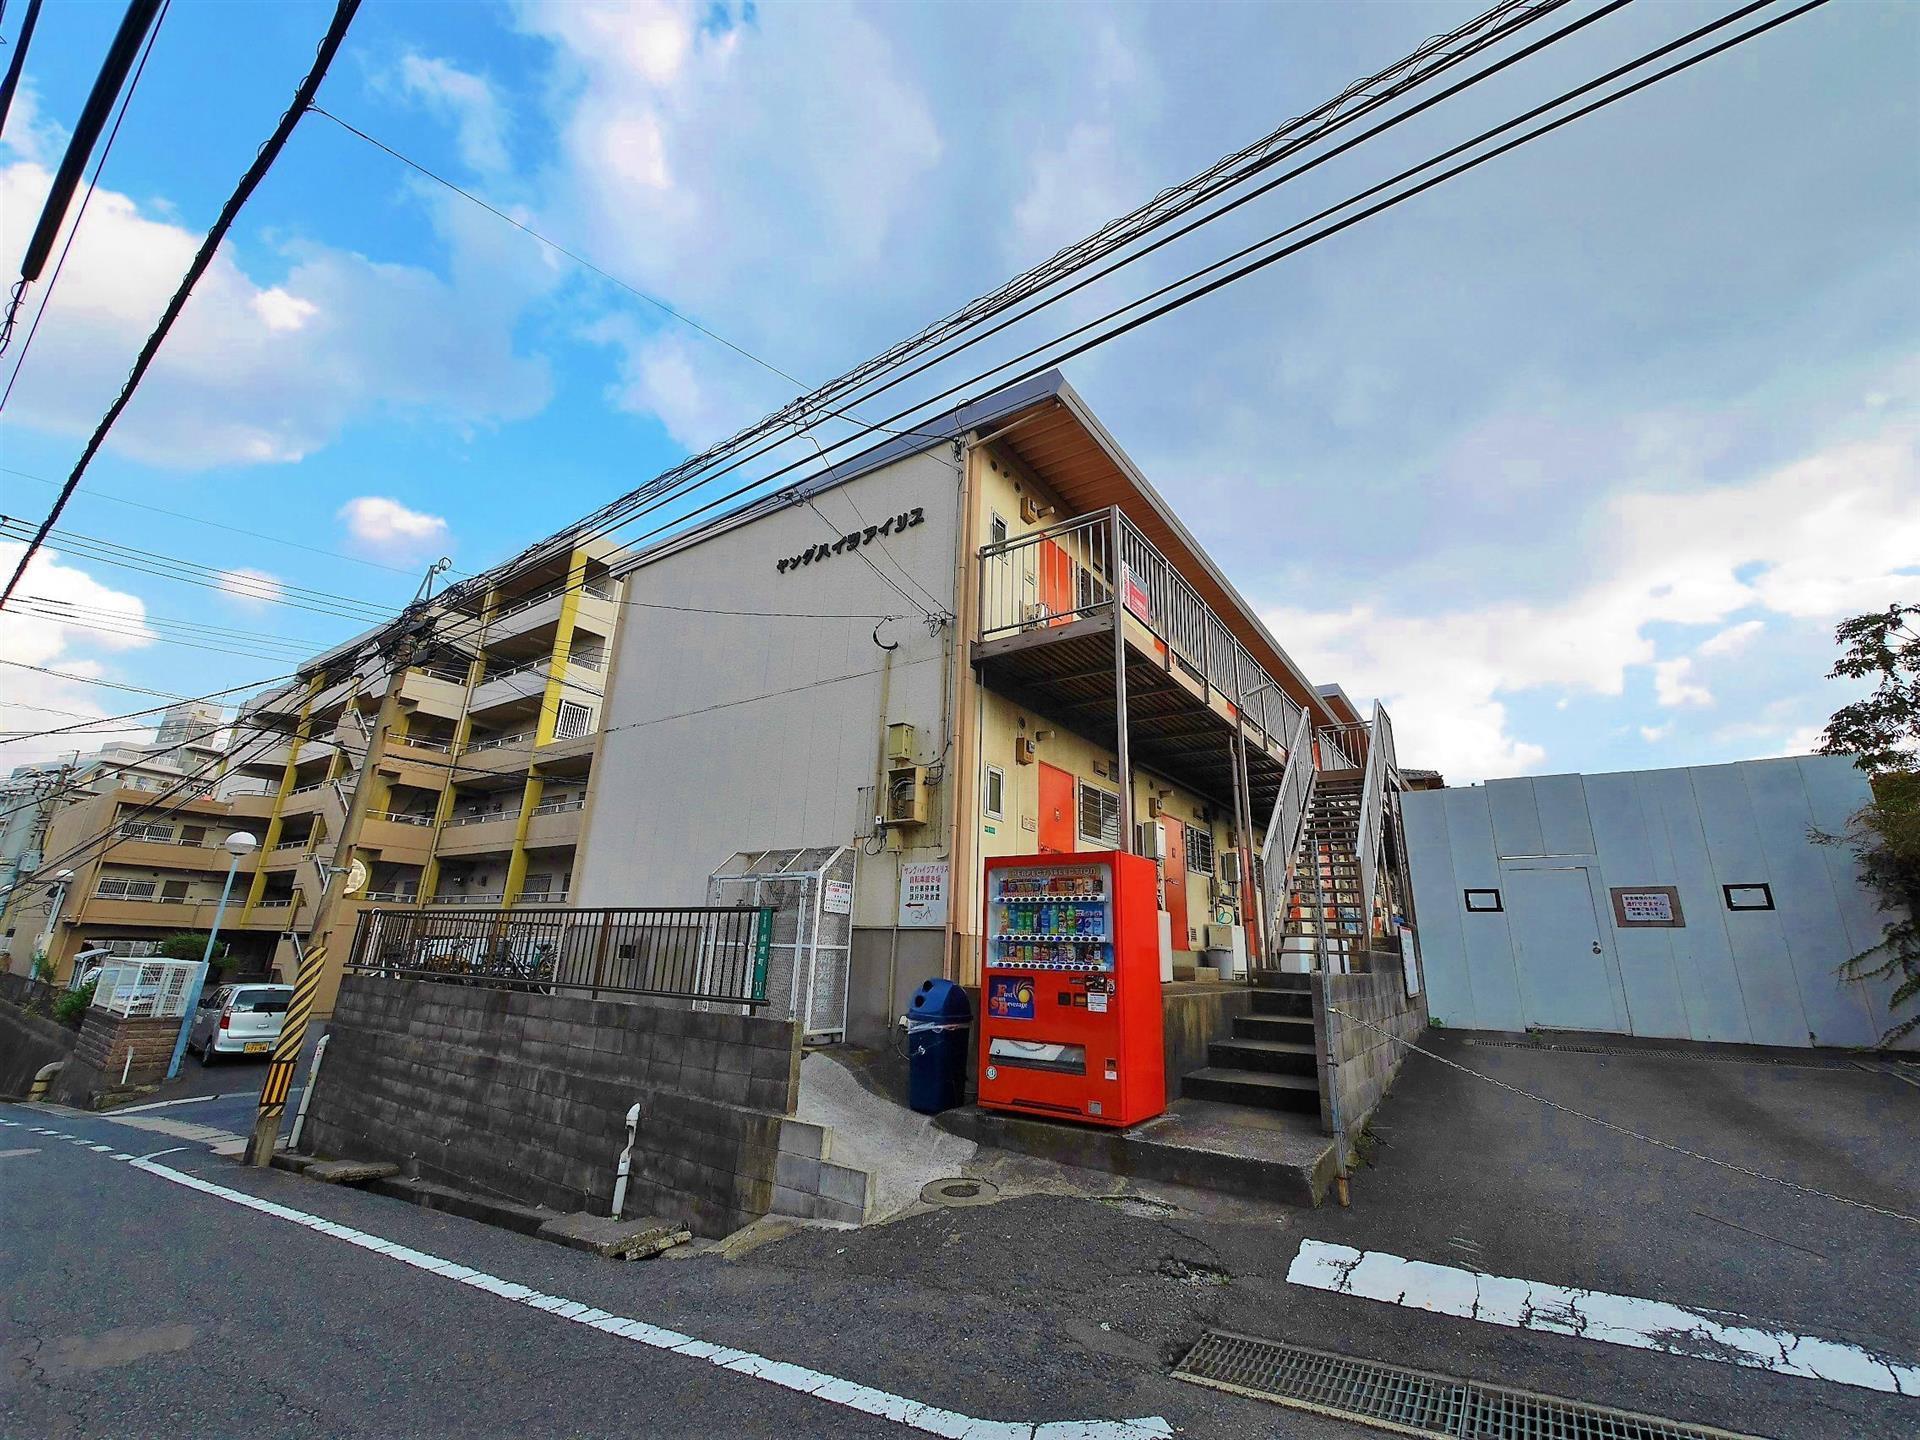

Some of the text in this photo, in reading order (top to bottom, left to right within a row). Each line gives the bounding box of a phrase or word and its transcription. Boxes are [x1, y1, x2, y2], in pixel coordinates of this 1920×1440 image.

[776, 506, 925, 574] ヤングハイツアイリス
